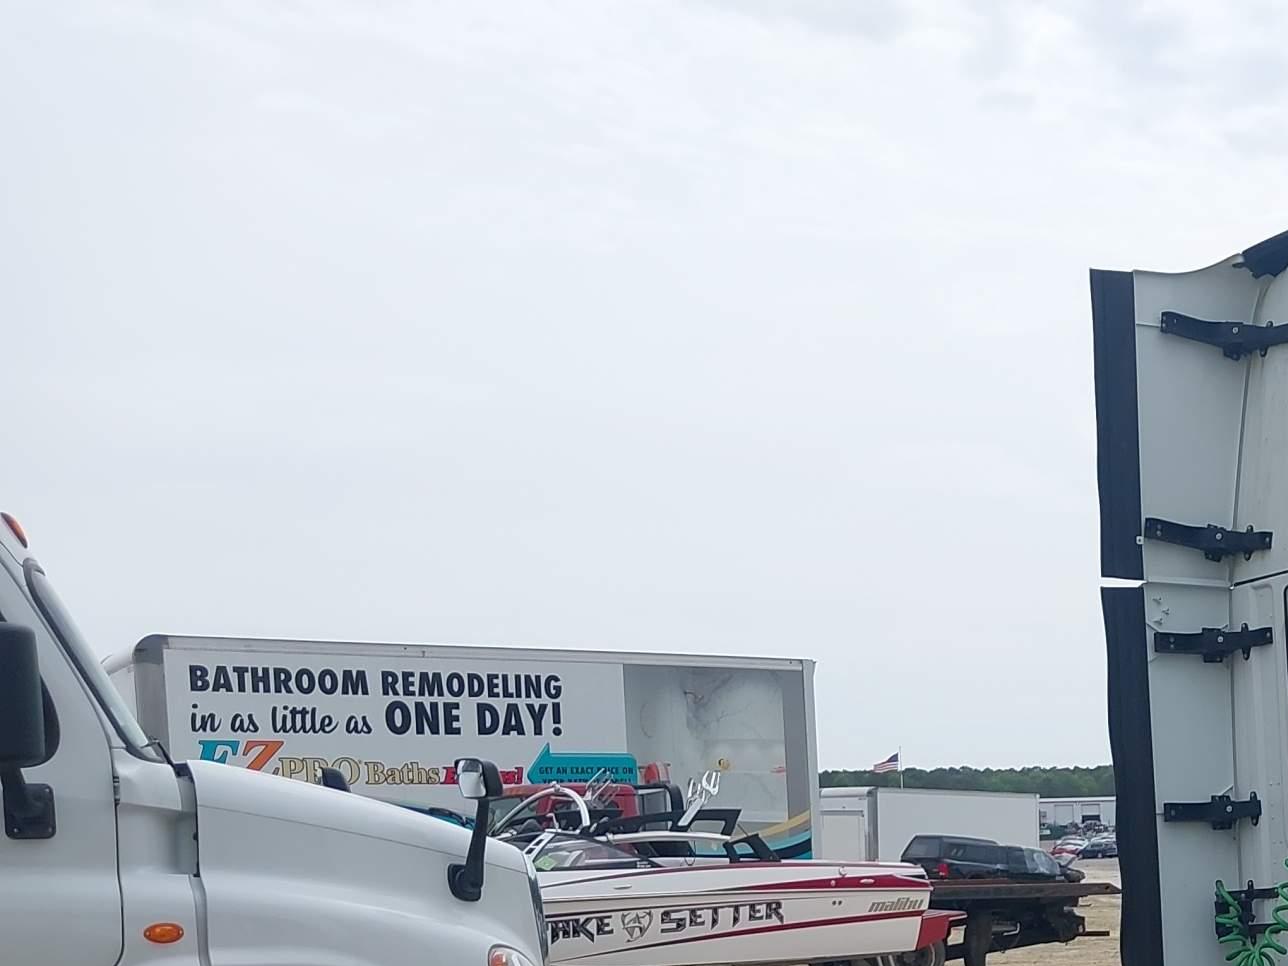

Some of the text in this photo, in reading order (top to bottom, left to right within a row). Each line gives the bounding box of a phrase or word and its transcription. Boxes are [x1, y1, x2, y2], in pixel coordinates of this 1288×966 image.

[189, 665, 562, 700] BATHROOM REMODELING
[190, 700, 563, 737] in as little as ONE DAY!
[365, 762, 440, 785] Baths
[539, 767, 553, 775] GET
[556, 767, 567, 775] AN
[571, 767, 594, 775] EXACT
[868, 897, 924, 913] malibu
[547, 901, 785, 945] AKE SETTER
